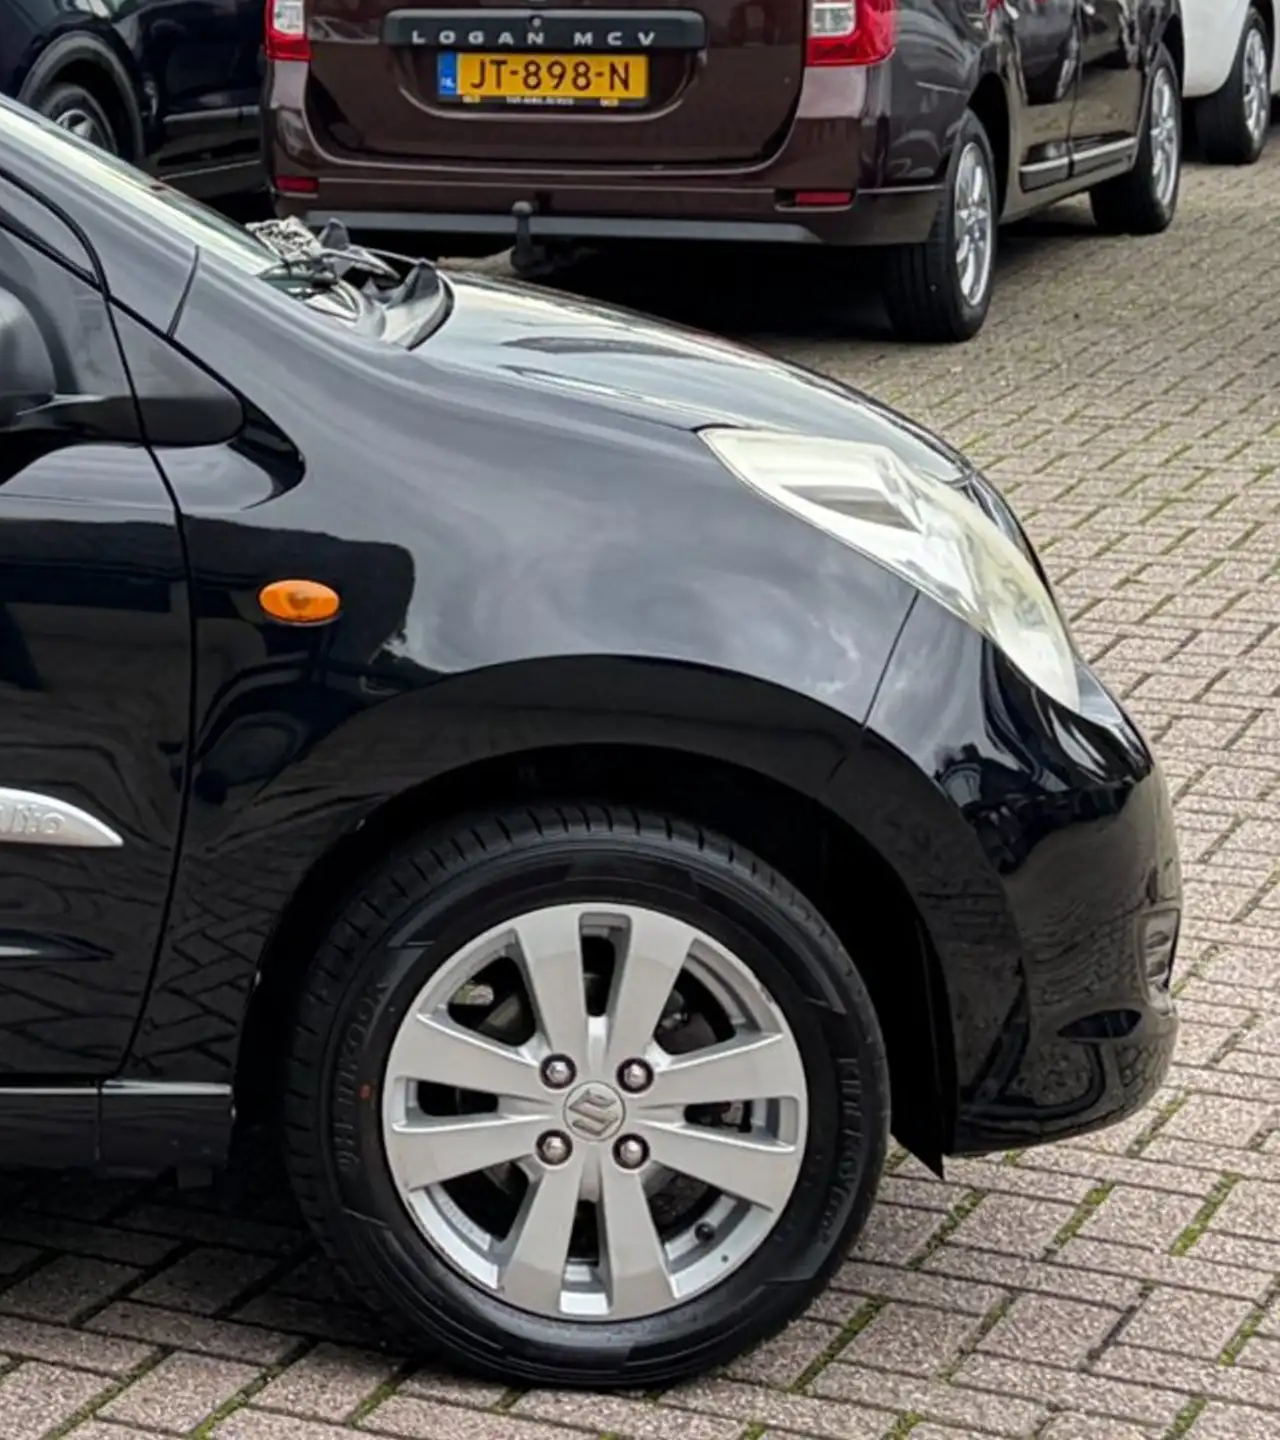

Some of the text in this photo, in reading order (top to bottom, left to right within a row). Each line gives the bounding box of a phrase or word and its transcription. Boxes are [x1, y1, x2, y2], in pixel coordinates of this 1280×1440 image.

[411, 31, 657, 46] LOGAN MCV
[470, 59, 631, 92] JT-898-N
